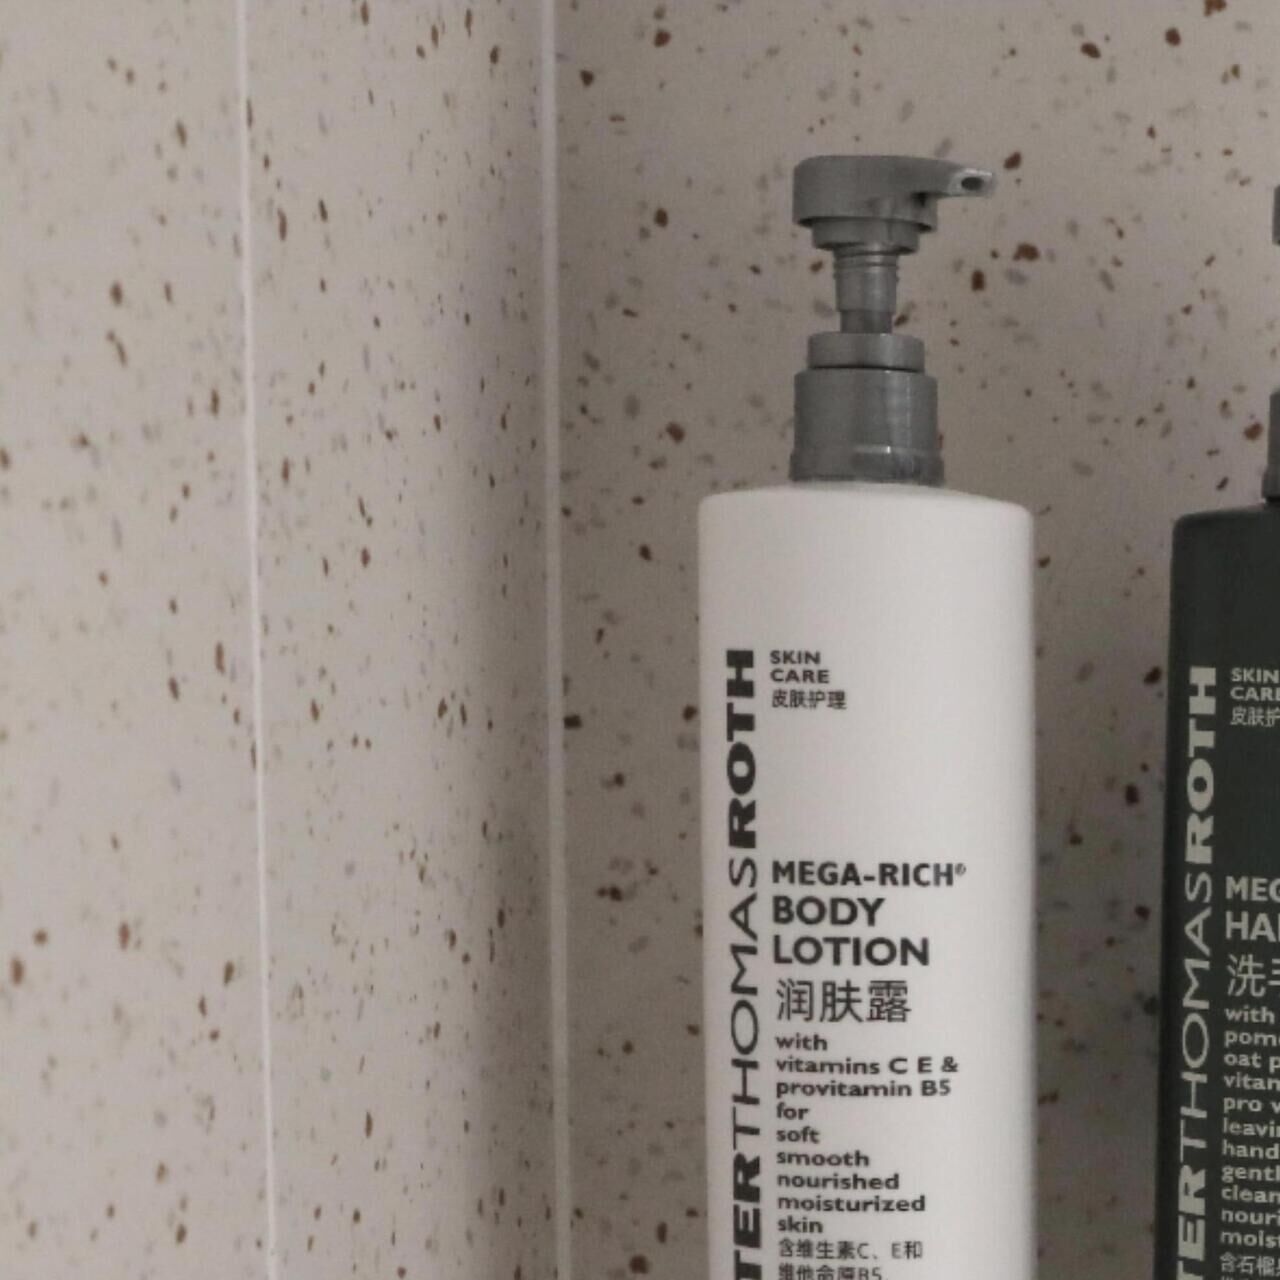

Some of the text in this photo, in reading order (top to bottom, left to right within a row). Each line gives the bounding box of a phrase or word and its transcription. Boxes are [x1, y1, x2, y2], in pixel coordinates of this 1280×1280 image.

[769, 649, 821, 666] SKIN
[769, 667, 830, 685] CARE
[1231, 667, 1280, 684] SKIN
[771, 688, 847, 710] 皮肤护理
[772, 895, 886, 927] BODY
[773, 934, 930, 967] LOTION
[775, 978, 912, 1024] 润肤露
[1223, 1004, 1276, 1025] with
[774, 1032, 828, 1052] with
[775, 1055, 959, 1076] vitamins C E &
[1223, 1052, 1262, 1068] oat
[776, 1078, 951, 1099] provitamin B5
[776, 1101, 810, 1121] for
[1223, 1097, 1263, 1114] pro
[775, 1125, 820, 1145] soft
[776, 1149, 870, 1168] smooth
[776, 1172, 900, 1191] nourished
[777, 1194, 926, 1213] moisturized
[777, 1215, 824, 1234] skin
